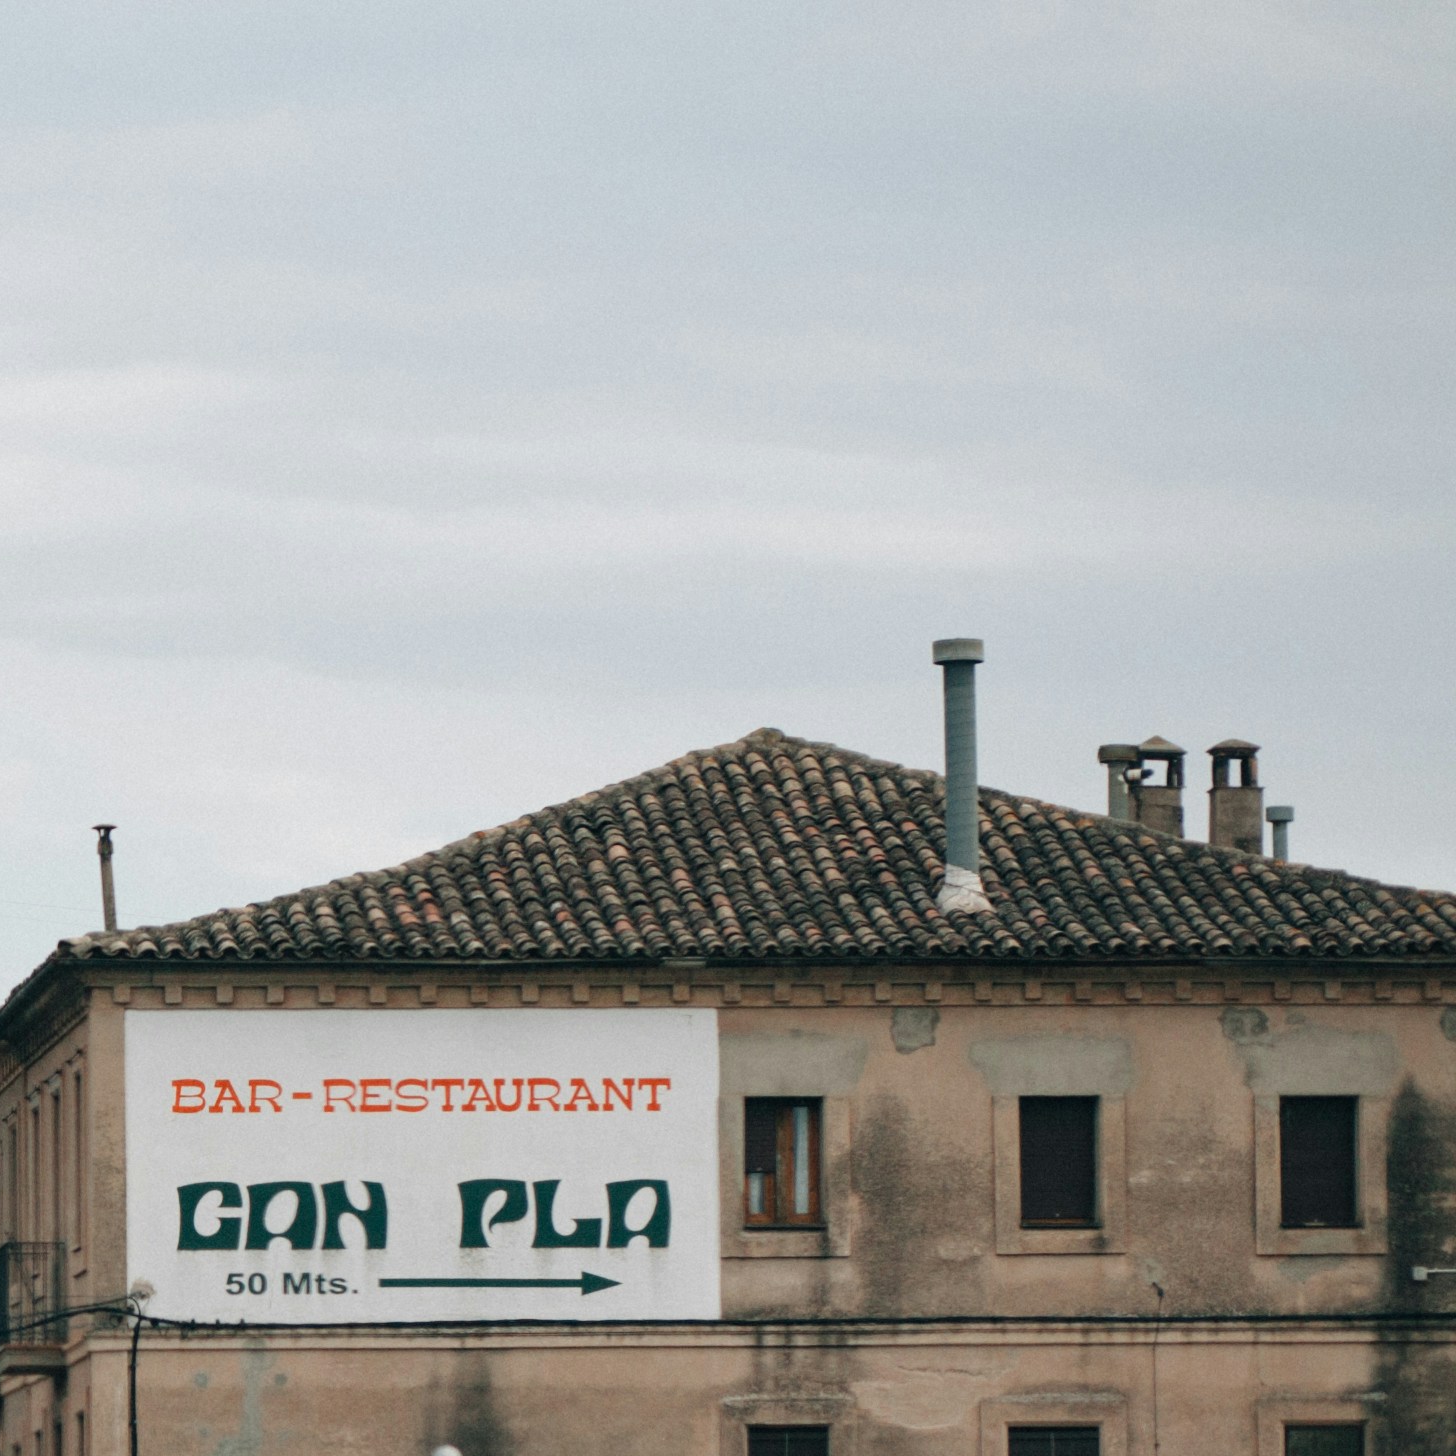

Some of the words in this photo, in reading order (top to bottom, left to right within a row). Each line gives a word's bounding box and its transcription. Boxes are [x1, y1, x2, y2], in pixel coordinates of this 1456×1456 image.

[170, 1077, 673, 1115] BAR-RESTAURANT
[176, 1180, 388, 1251] CAN
[457, 1178, 671, 1249] PLA
[225, 1272, 267, 1296] 50
[282, 1272, 359, 1296] Mts.
